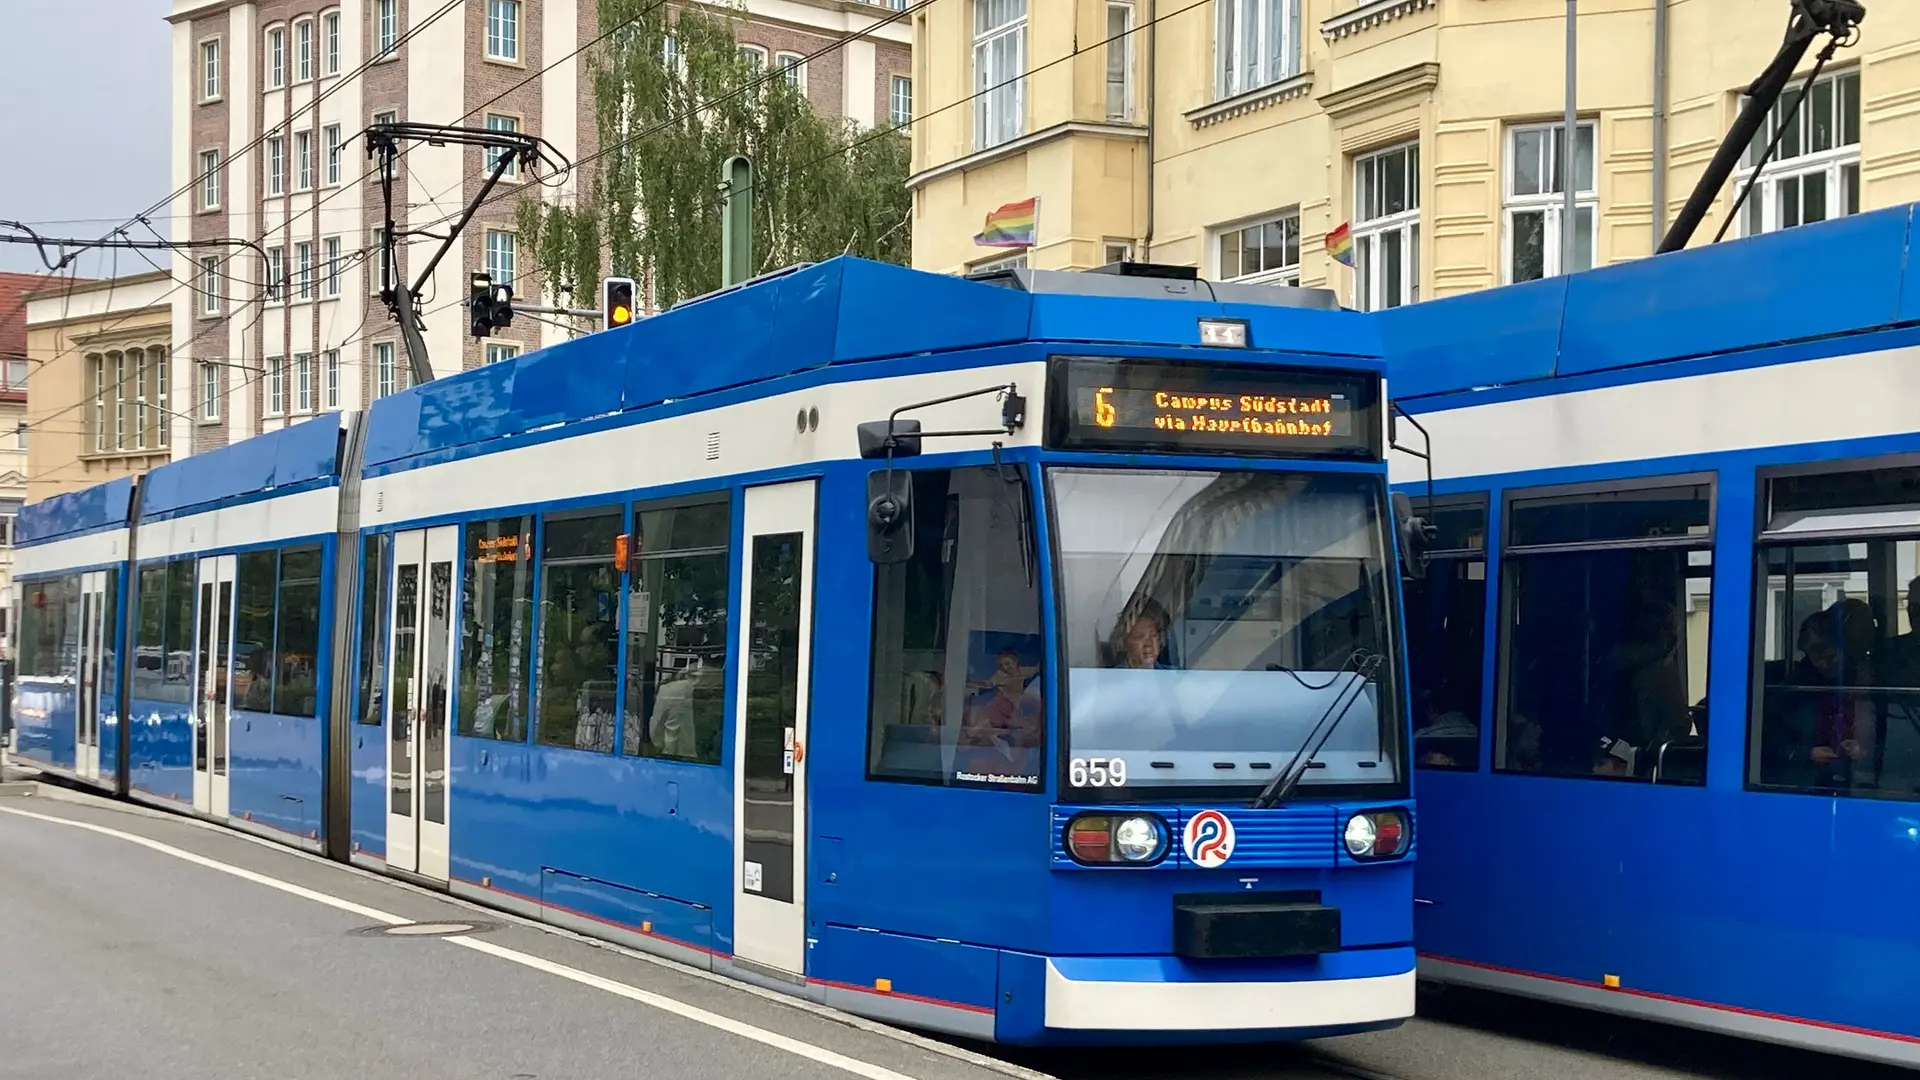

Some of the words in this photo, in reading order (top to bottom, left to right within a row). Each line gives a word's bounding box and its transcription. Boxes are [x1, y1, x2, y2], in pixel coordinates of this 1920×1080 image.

[1094, 387, 1117, 428] 6
[1154, 392, 1233, 411] Campus
[1239, 395, 1331, 414] Südstadt
[1154, 414, 1187, 431] via
[1191, 415, 1332, 436] Hauptbahnhof
[1026, 775, 1038, 785] AG
[1069, 757, 1127, 788] 659
